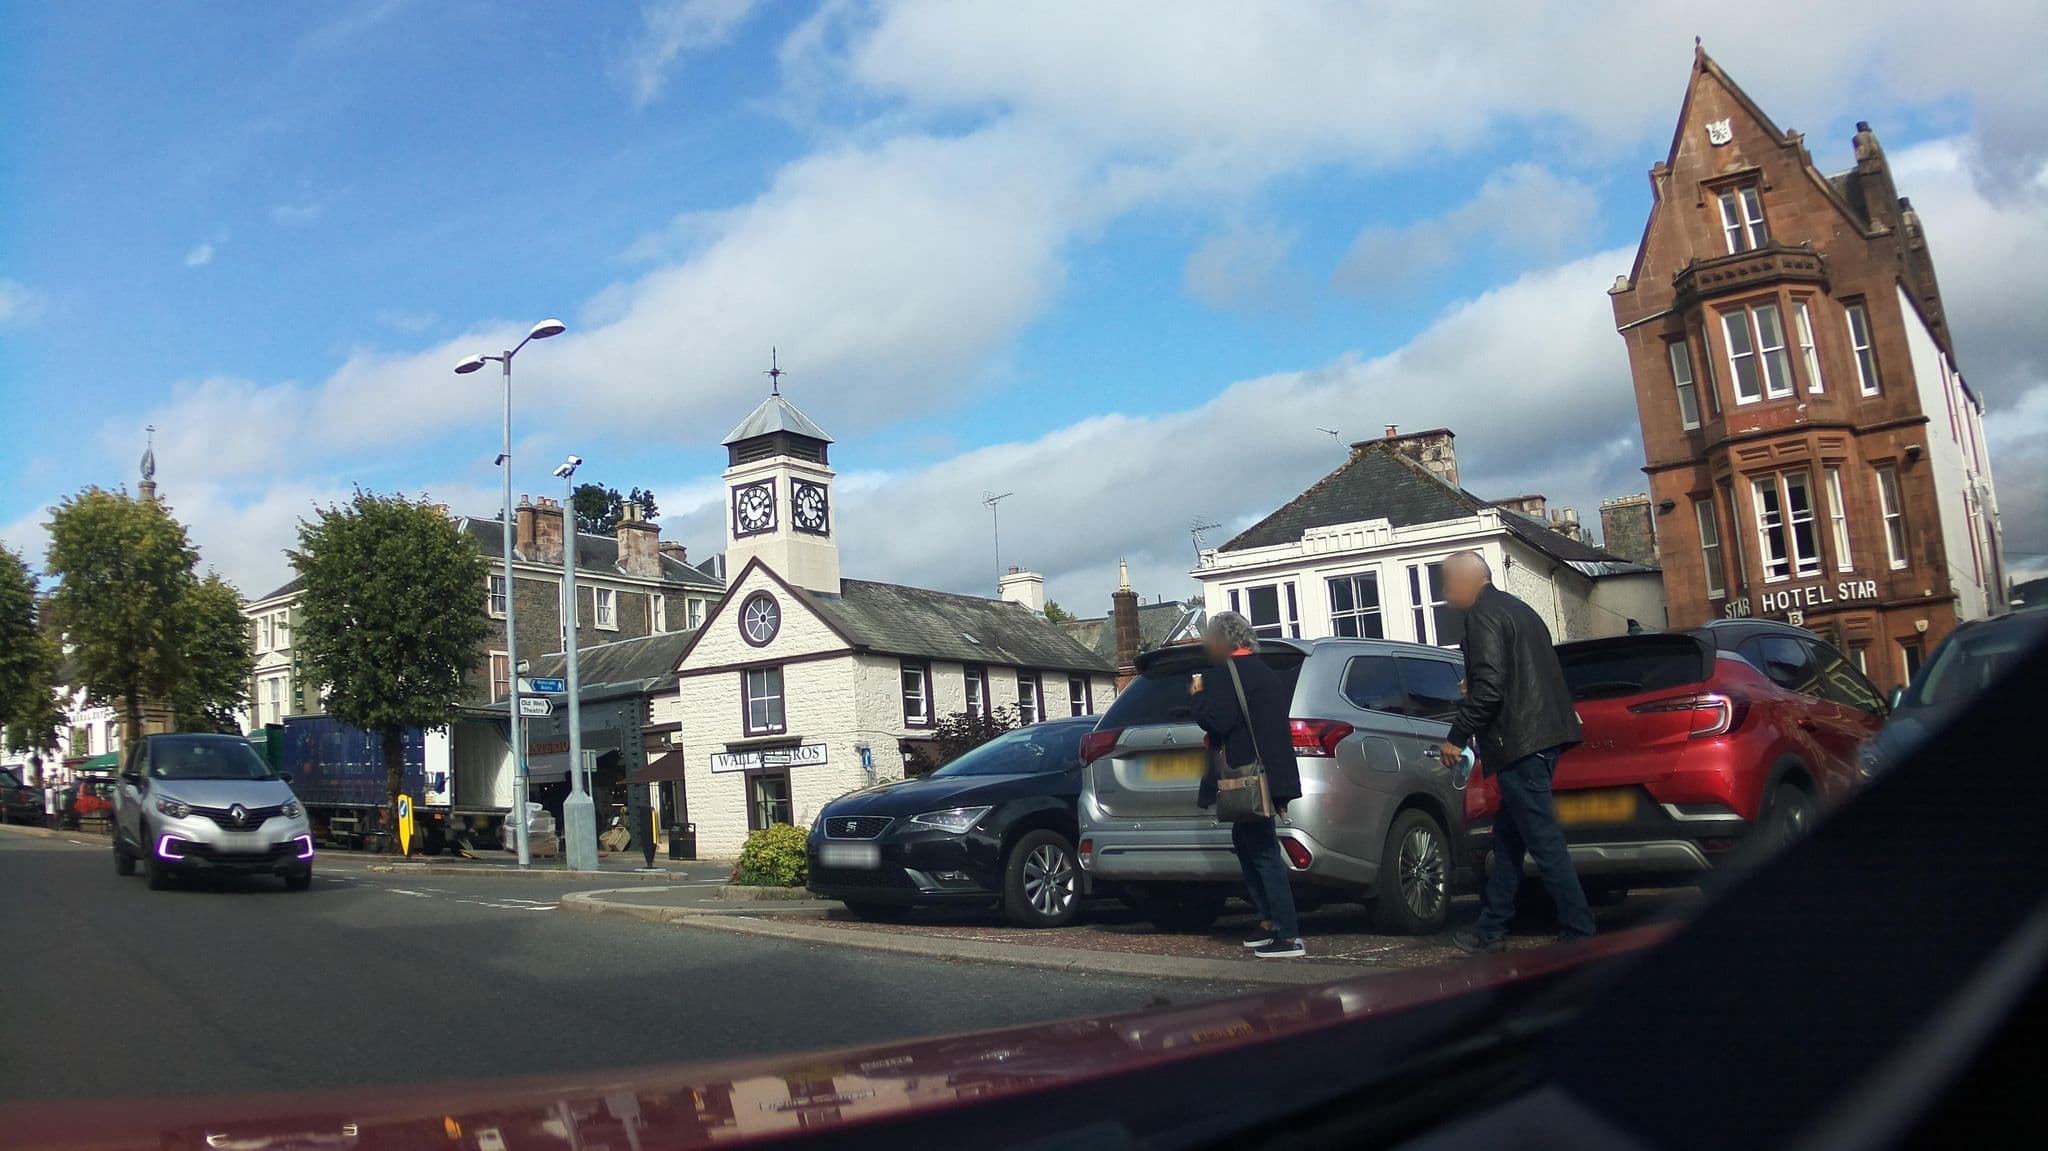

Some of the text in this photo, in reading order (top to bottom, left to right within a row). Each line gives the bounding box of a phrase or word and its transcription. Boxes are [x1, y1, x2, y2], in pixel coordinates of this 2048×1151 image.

[1725, 580, 1878, 619] STAR HOTEL STAR
